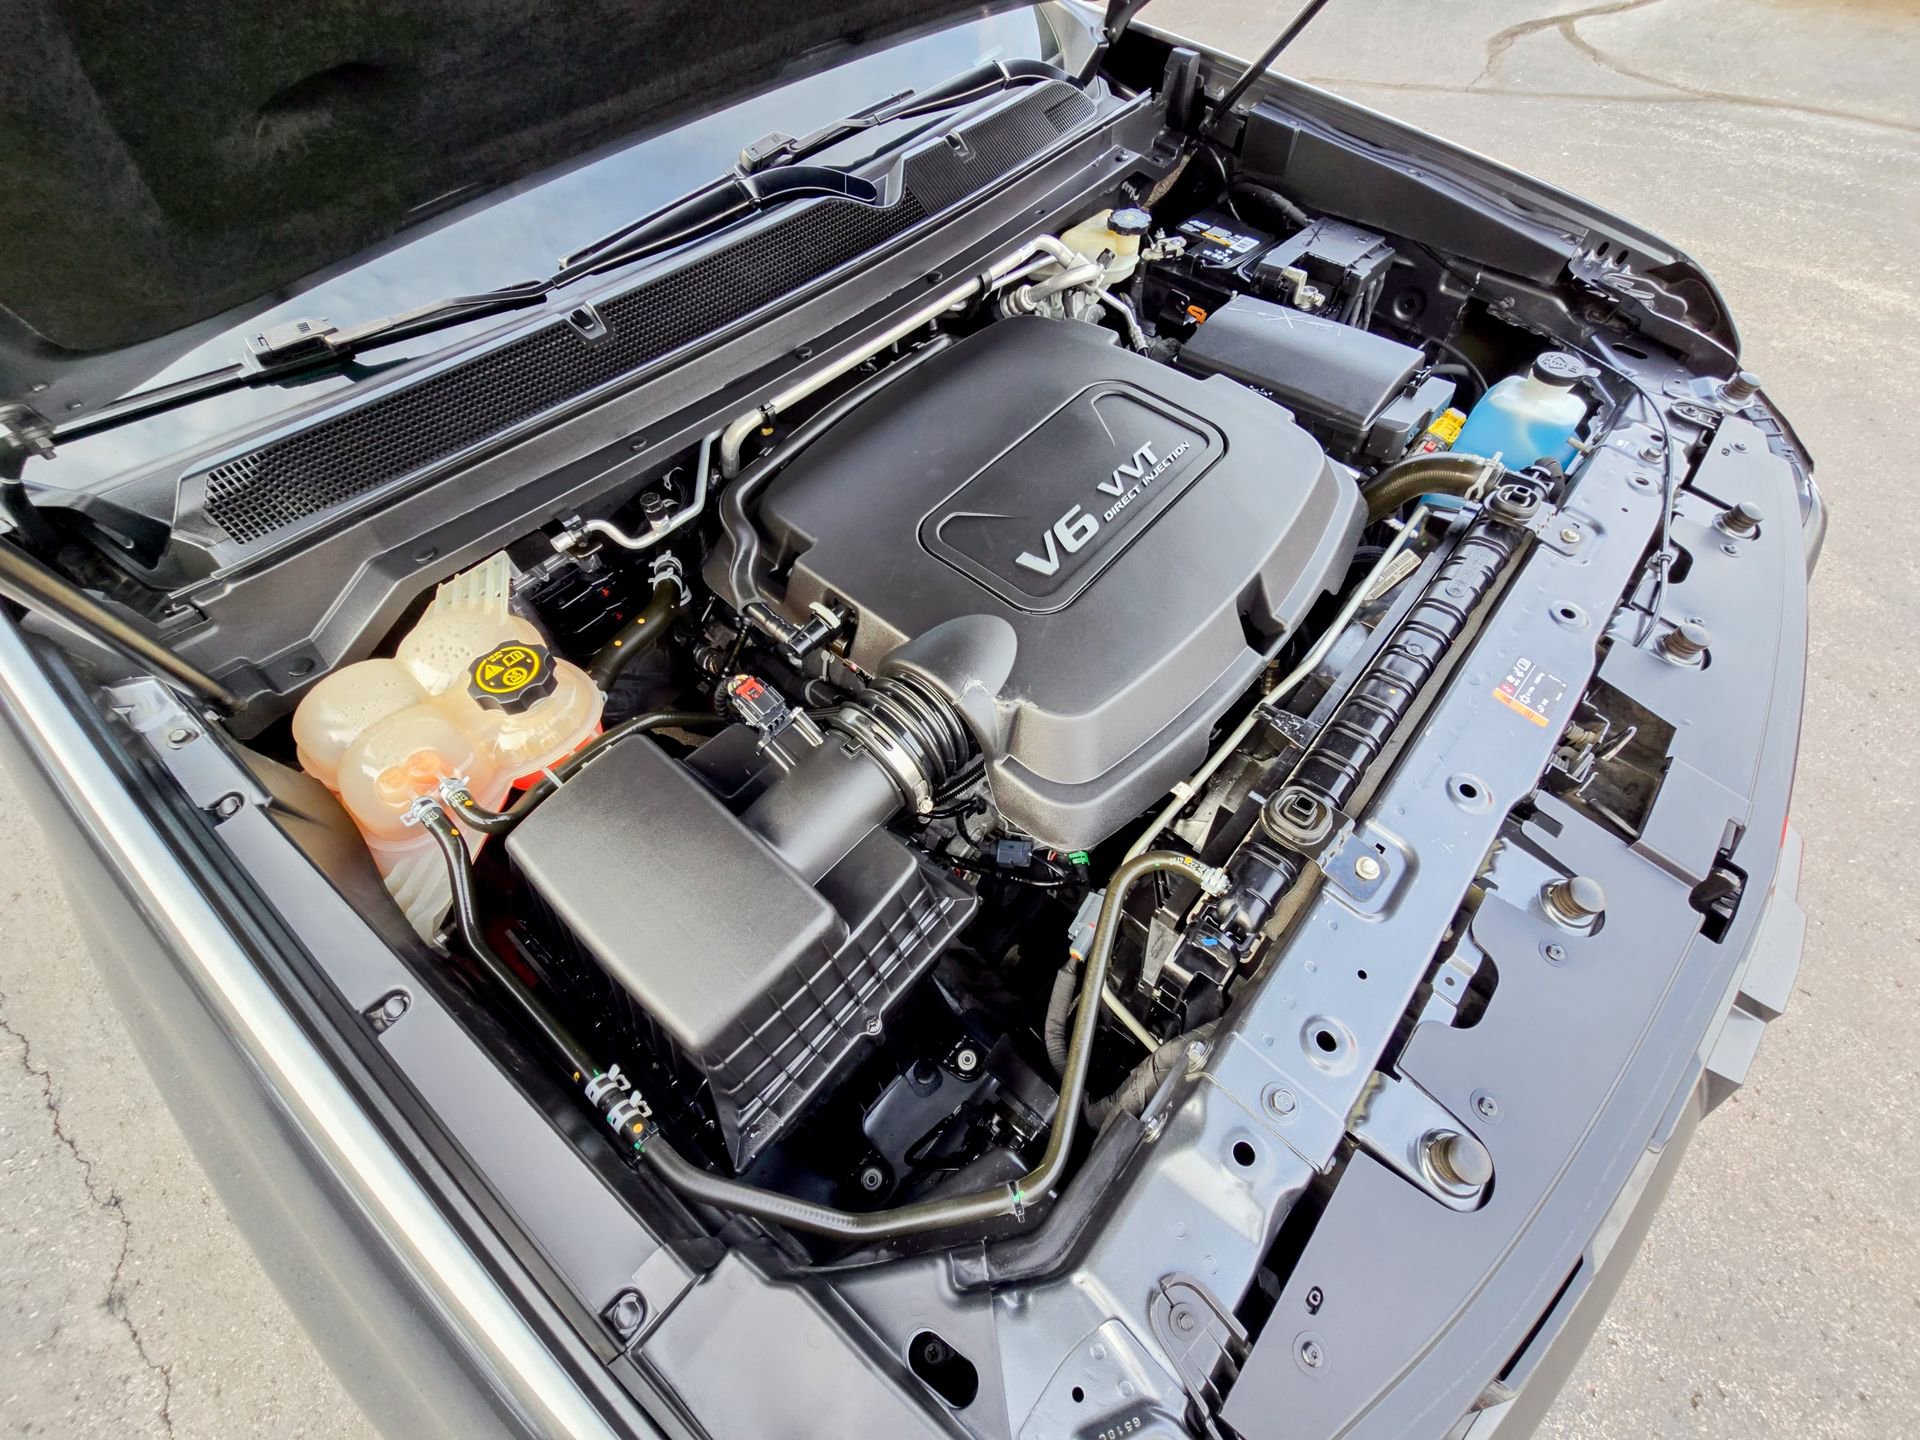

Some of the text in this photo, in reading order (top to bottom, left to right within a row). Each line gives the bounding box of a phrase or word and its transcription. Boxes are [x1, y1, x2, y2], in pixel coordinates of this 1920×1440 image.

[1015, 441, 1158, 576] V6 VVT
[1103, 441, 1190, 522] DIRECT INJECTION
